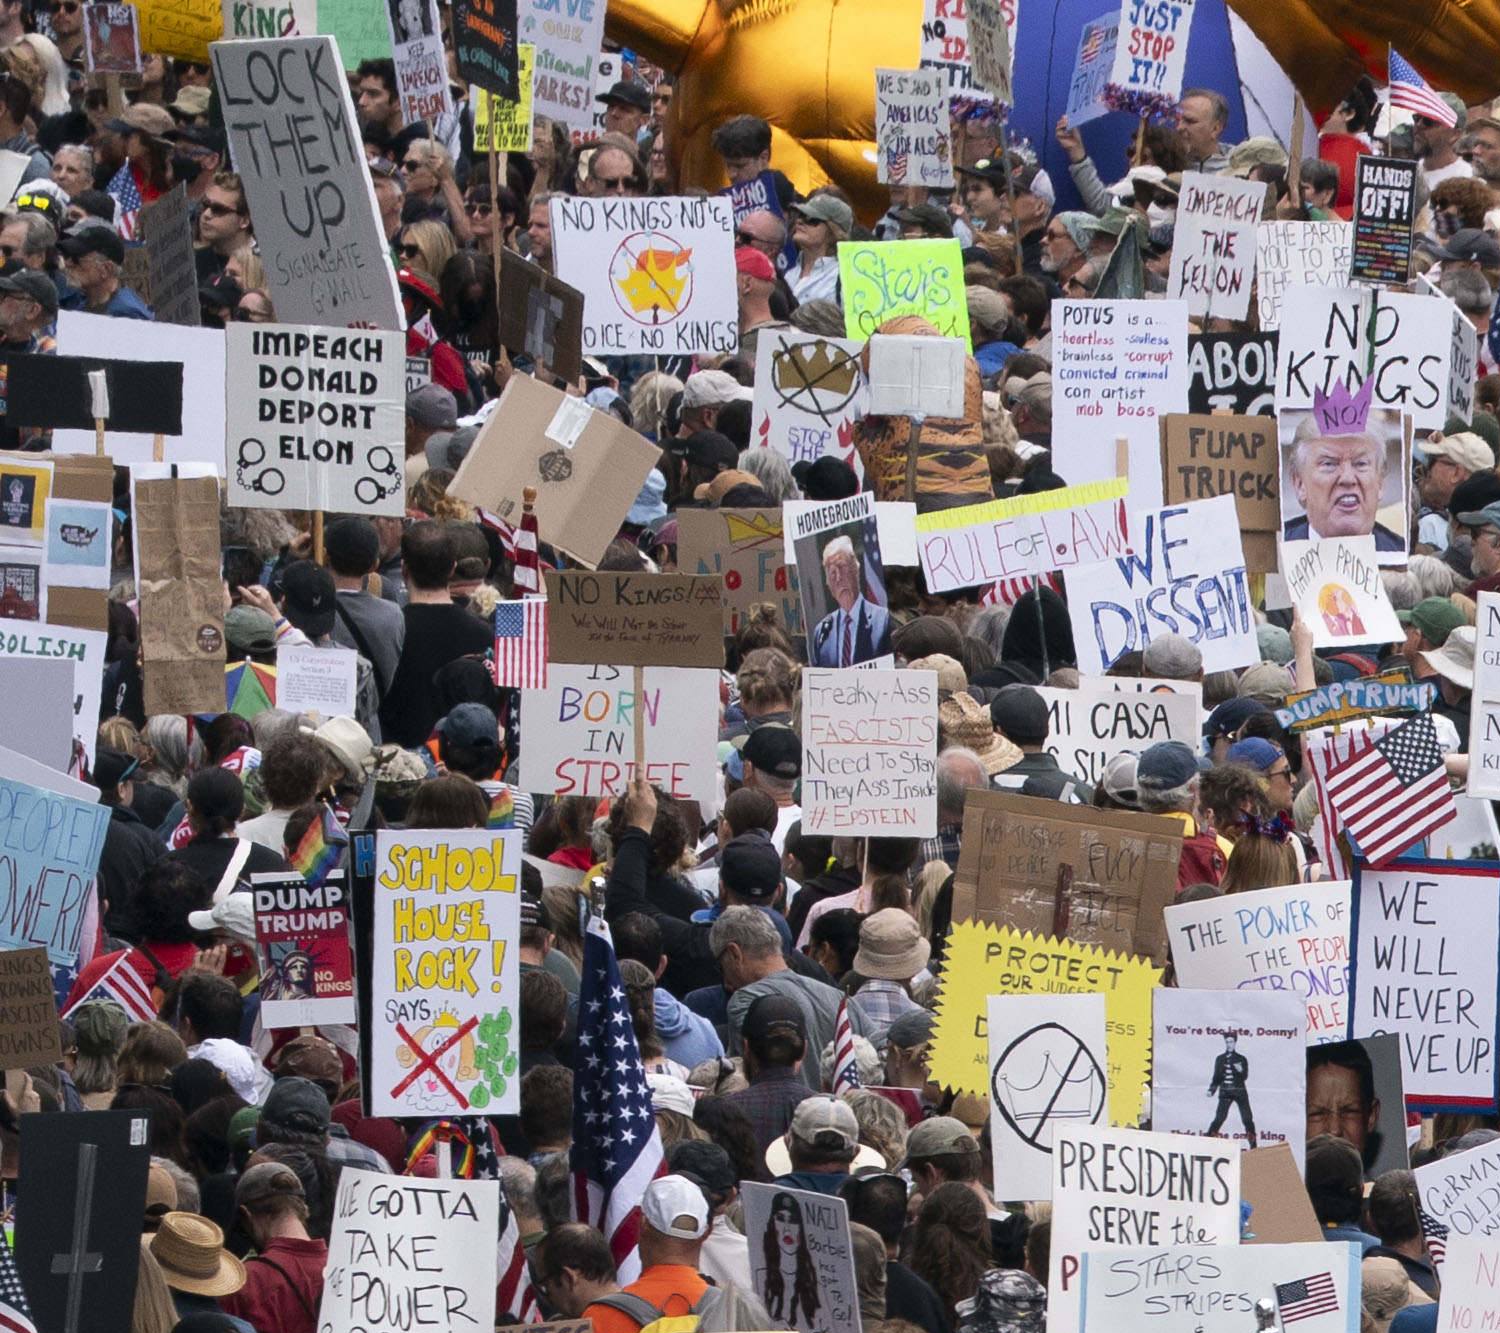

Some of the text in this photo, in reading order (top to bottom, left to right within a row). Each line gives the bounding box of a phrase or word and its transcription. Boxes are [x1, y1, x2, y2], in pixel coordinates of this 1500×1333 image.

[1128, 28, 1175, 62] STOP
[215, 45, 337, 106] LOCK
[401, 68, 441, 92] IMPEACH
[408, 93, 445, 120] FELON
[232, 103, 355, 178] THEM
[1362, 162, 1413, 188] HANDS
[1184, 188, 1262, 227] IMPEACH
[1361, 188, 1412, 222] OFF!
[1181, 256, 1245, 297] FELON
[1328, 300, 1400, 350] NO
[252, 330, 384, 362] IMPEACH
[258, 364, 378, 395] DONALD
[259, 399, 373, 430] DEPORT
[1076, 403, 1155, 418] mob boss
[279, 434, 355, 466] ELON
[1189, 427, 1266, 461] FUMP
[1177, 465, 1275, 501] TRUCK
[379, 842, 516, 894] SCHOOL
[255, 885, 345, 912] DUMP
[257, 908, 345, 936] TRUMP
[1371, 984, 1477, 1028] NEVER
[1059, 1141, 1231, 1202] PRESIDENTS
[1088, 1206, 1217, 1245] SERVE the
[349, 1277, 478, 1327] POWER
